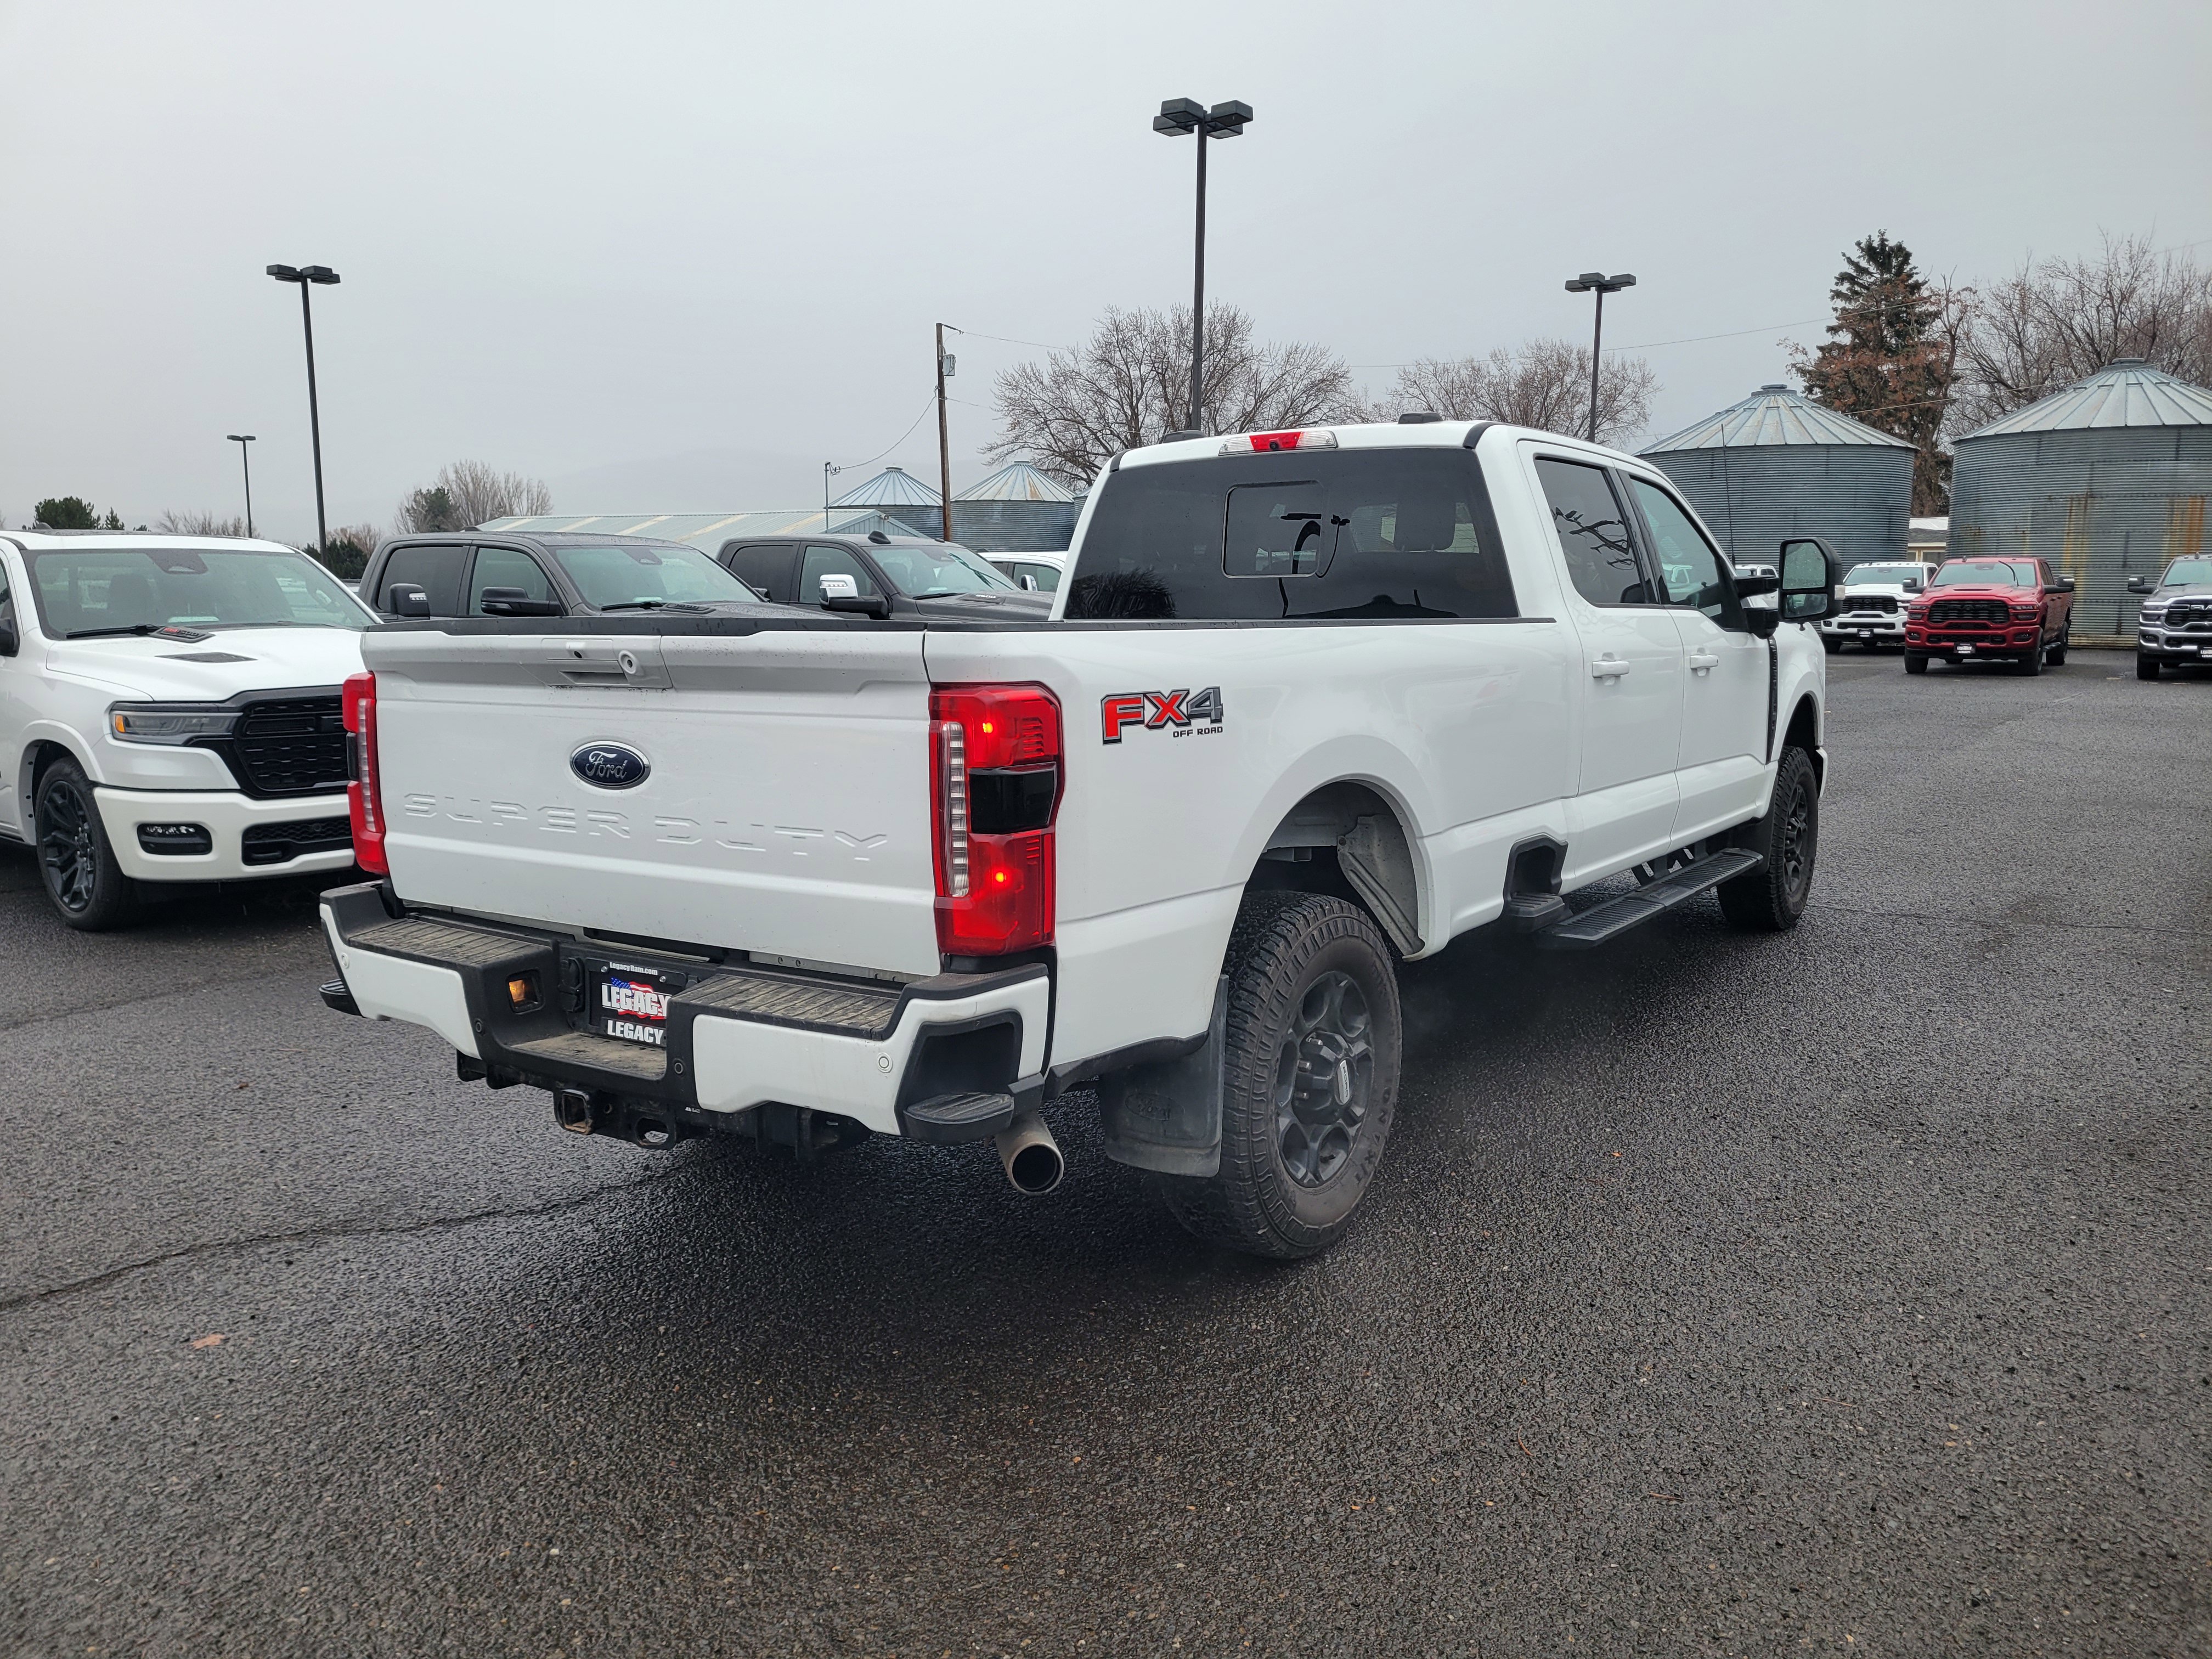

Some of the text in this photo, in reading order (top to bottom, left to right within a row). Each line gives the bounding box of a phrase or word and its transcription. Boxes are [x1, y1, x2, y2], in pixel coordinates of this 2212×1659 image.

[1101, 686, 1223, 746] FX4
[1172, 726, 1223, 738] OFF ROAD
[585, 751, 628, 780] Ford
[404, 793, 888, 861] SUPER DUTY
[601, 984, 671, 1017] LEGACY
[607, 1020, 664, 1045] LEGACY
